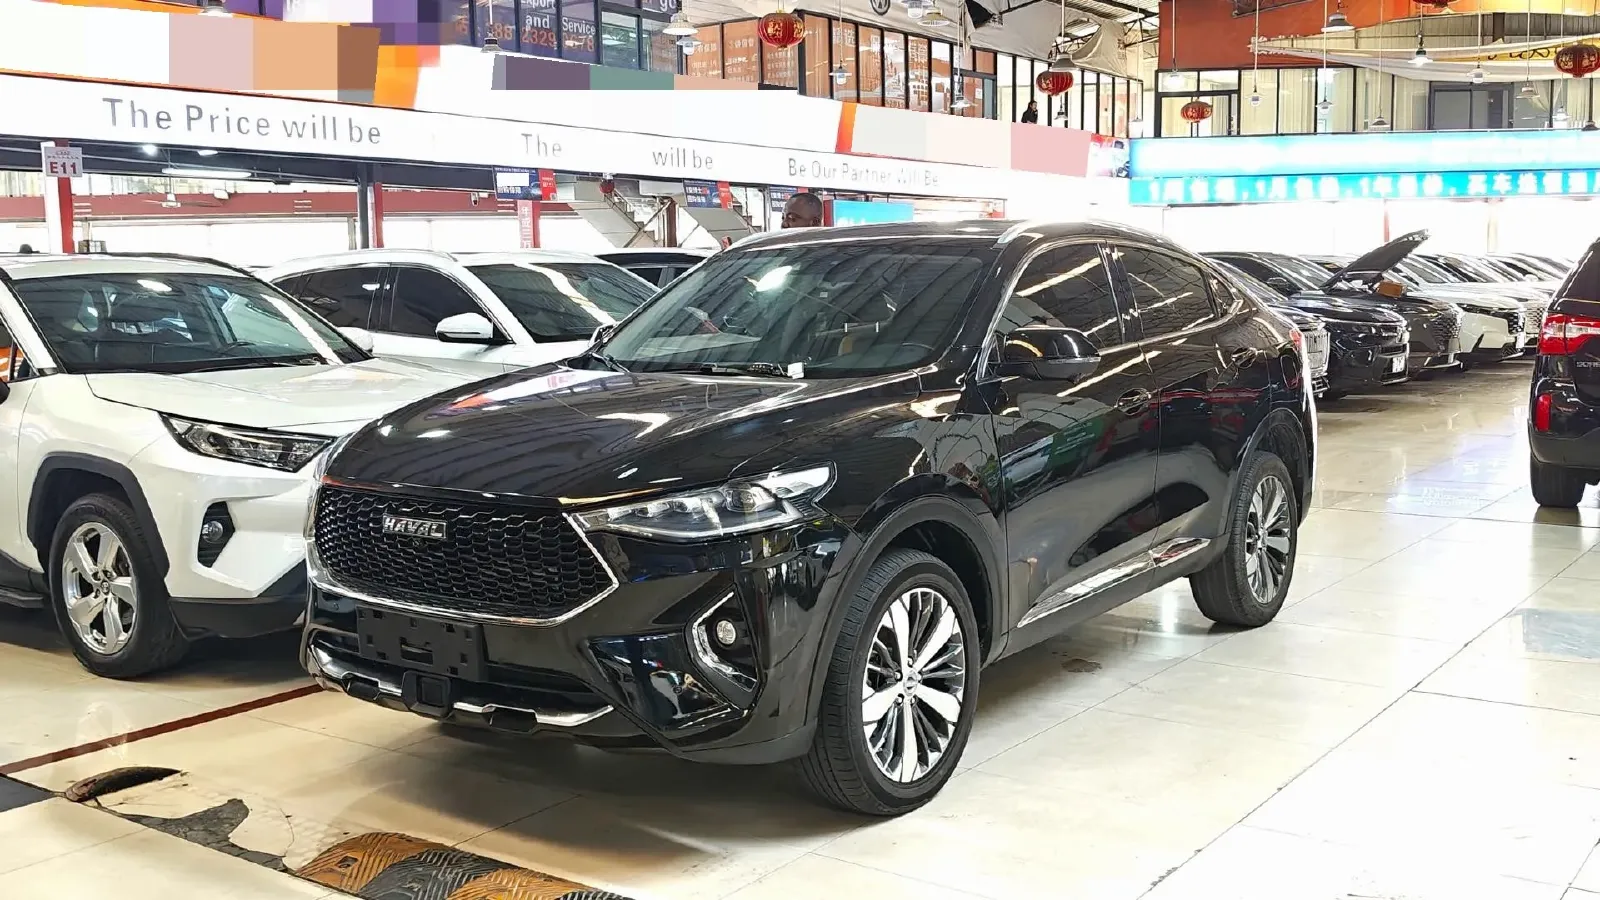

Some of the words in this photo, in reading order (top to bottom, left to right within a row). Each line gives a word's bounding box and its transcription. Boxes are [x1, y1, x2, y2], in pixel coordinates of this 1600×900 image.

[520, 0, 557, 9] port
[525, 14, 550, 29] and
[561, 17, 596, 36] Service
[102, 97, 173, 130] The
[186, 104, 271, 137] Price
[281, 114, 338, 141] will
[349, 117, 381, 145] be
[520, 132, 562, 157] The
[652, 146, 686, 168] will
[692, 148, 713, 170] be
[50, 161, 77, 175] E11
[788, 157, 807, 177] Be
[811, 160, 838, 179] Our
[385, 517, 443, 537] HAVAL
